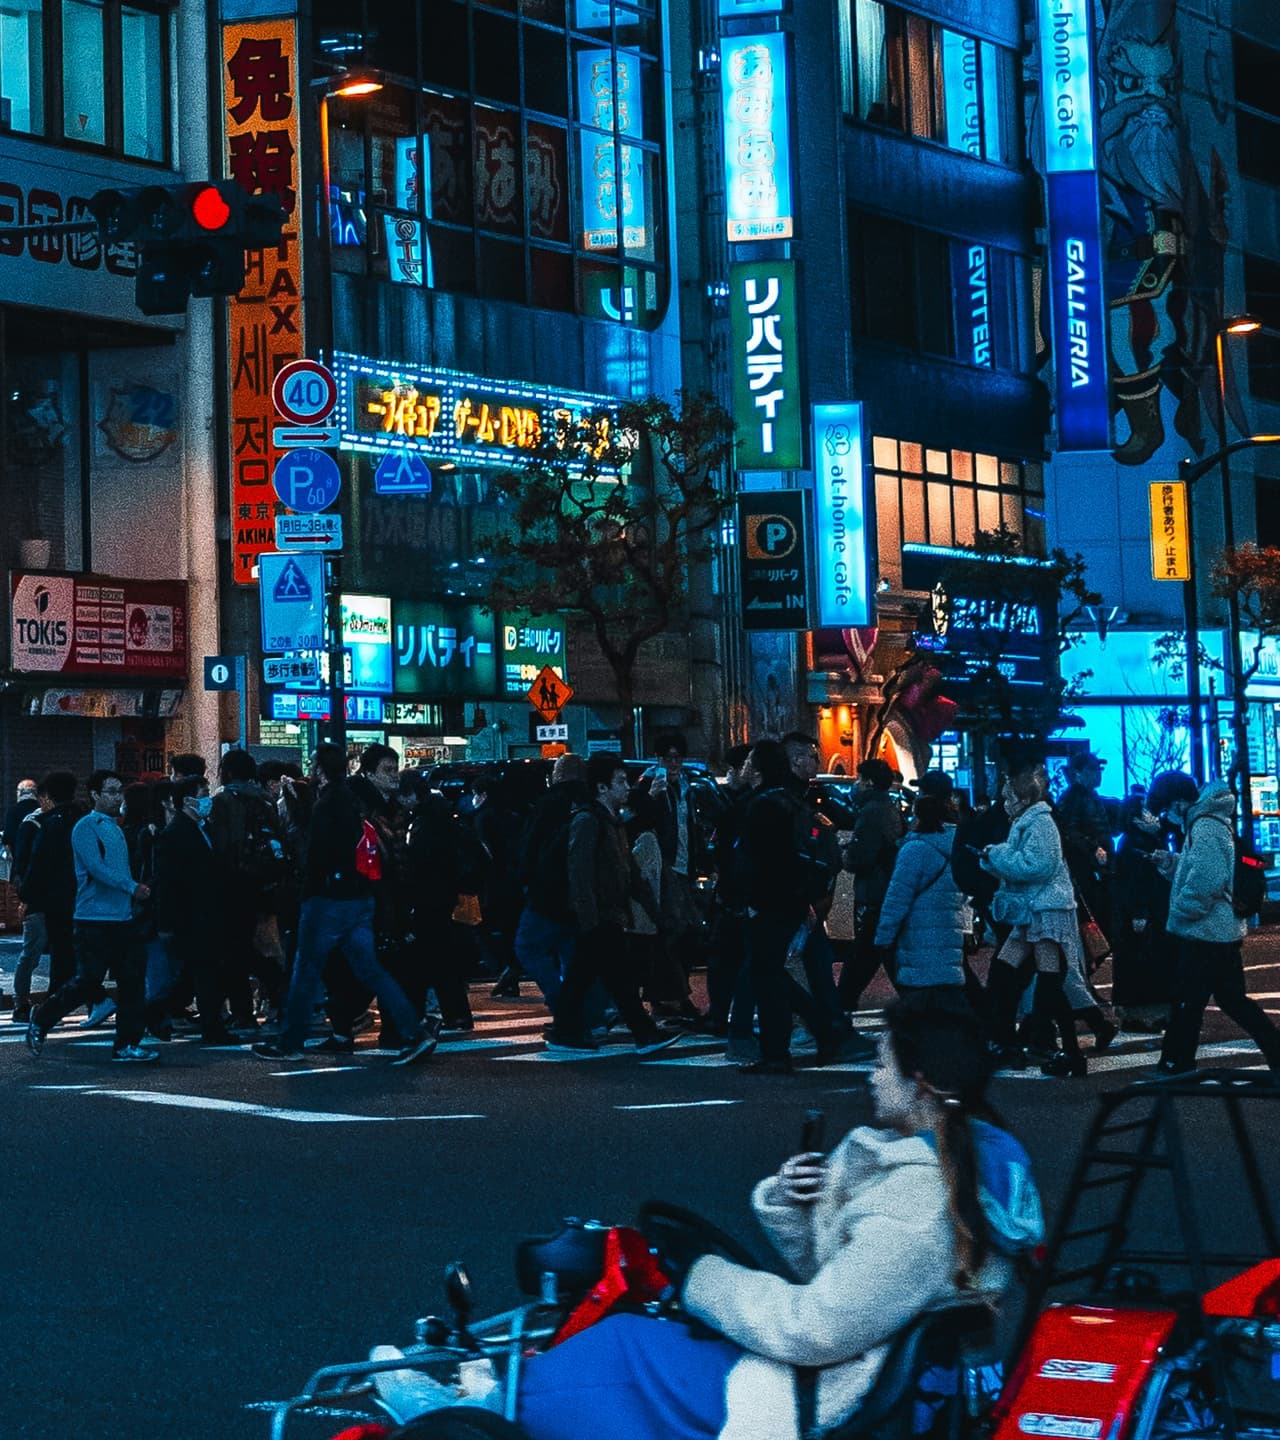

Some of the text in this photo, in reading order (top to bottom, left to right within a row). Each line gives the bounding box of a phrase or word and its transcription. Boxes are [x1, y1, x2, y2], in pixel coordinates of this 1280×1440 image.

[1054, 84, 1075, 151] cafe
[1066, 236, 1089, 389] GALLERIA
[287, 378, 324, 408] 40
[744, 277, 783, 454] リバティー
[288, 465, 316, 505] P
[830, 465, 849, 608] at-home cafe
[785, 594, 804, 612] IN
[396, 621, 492, 669] リバティー
